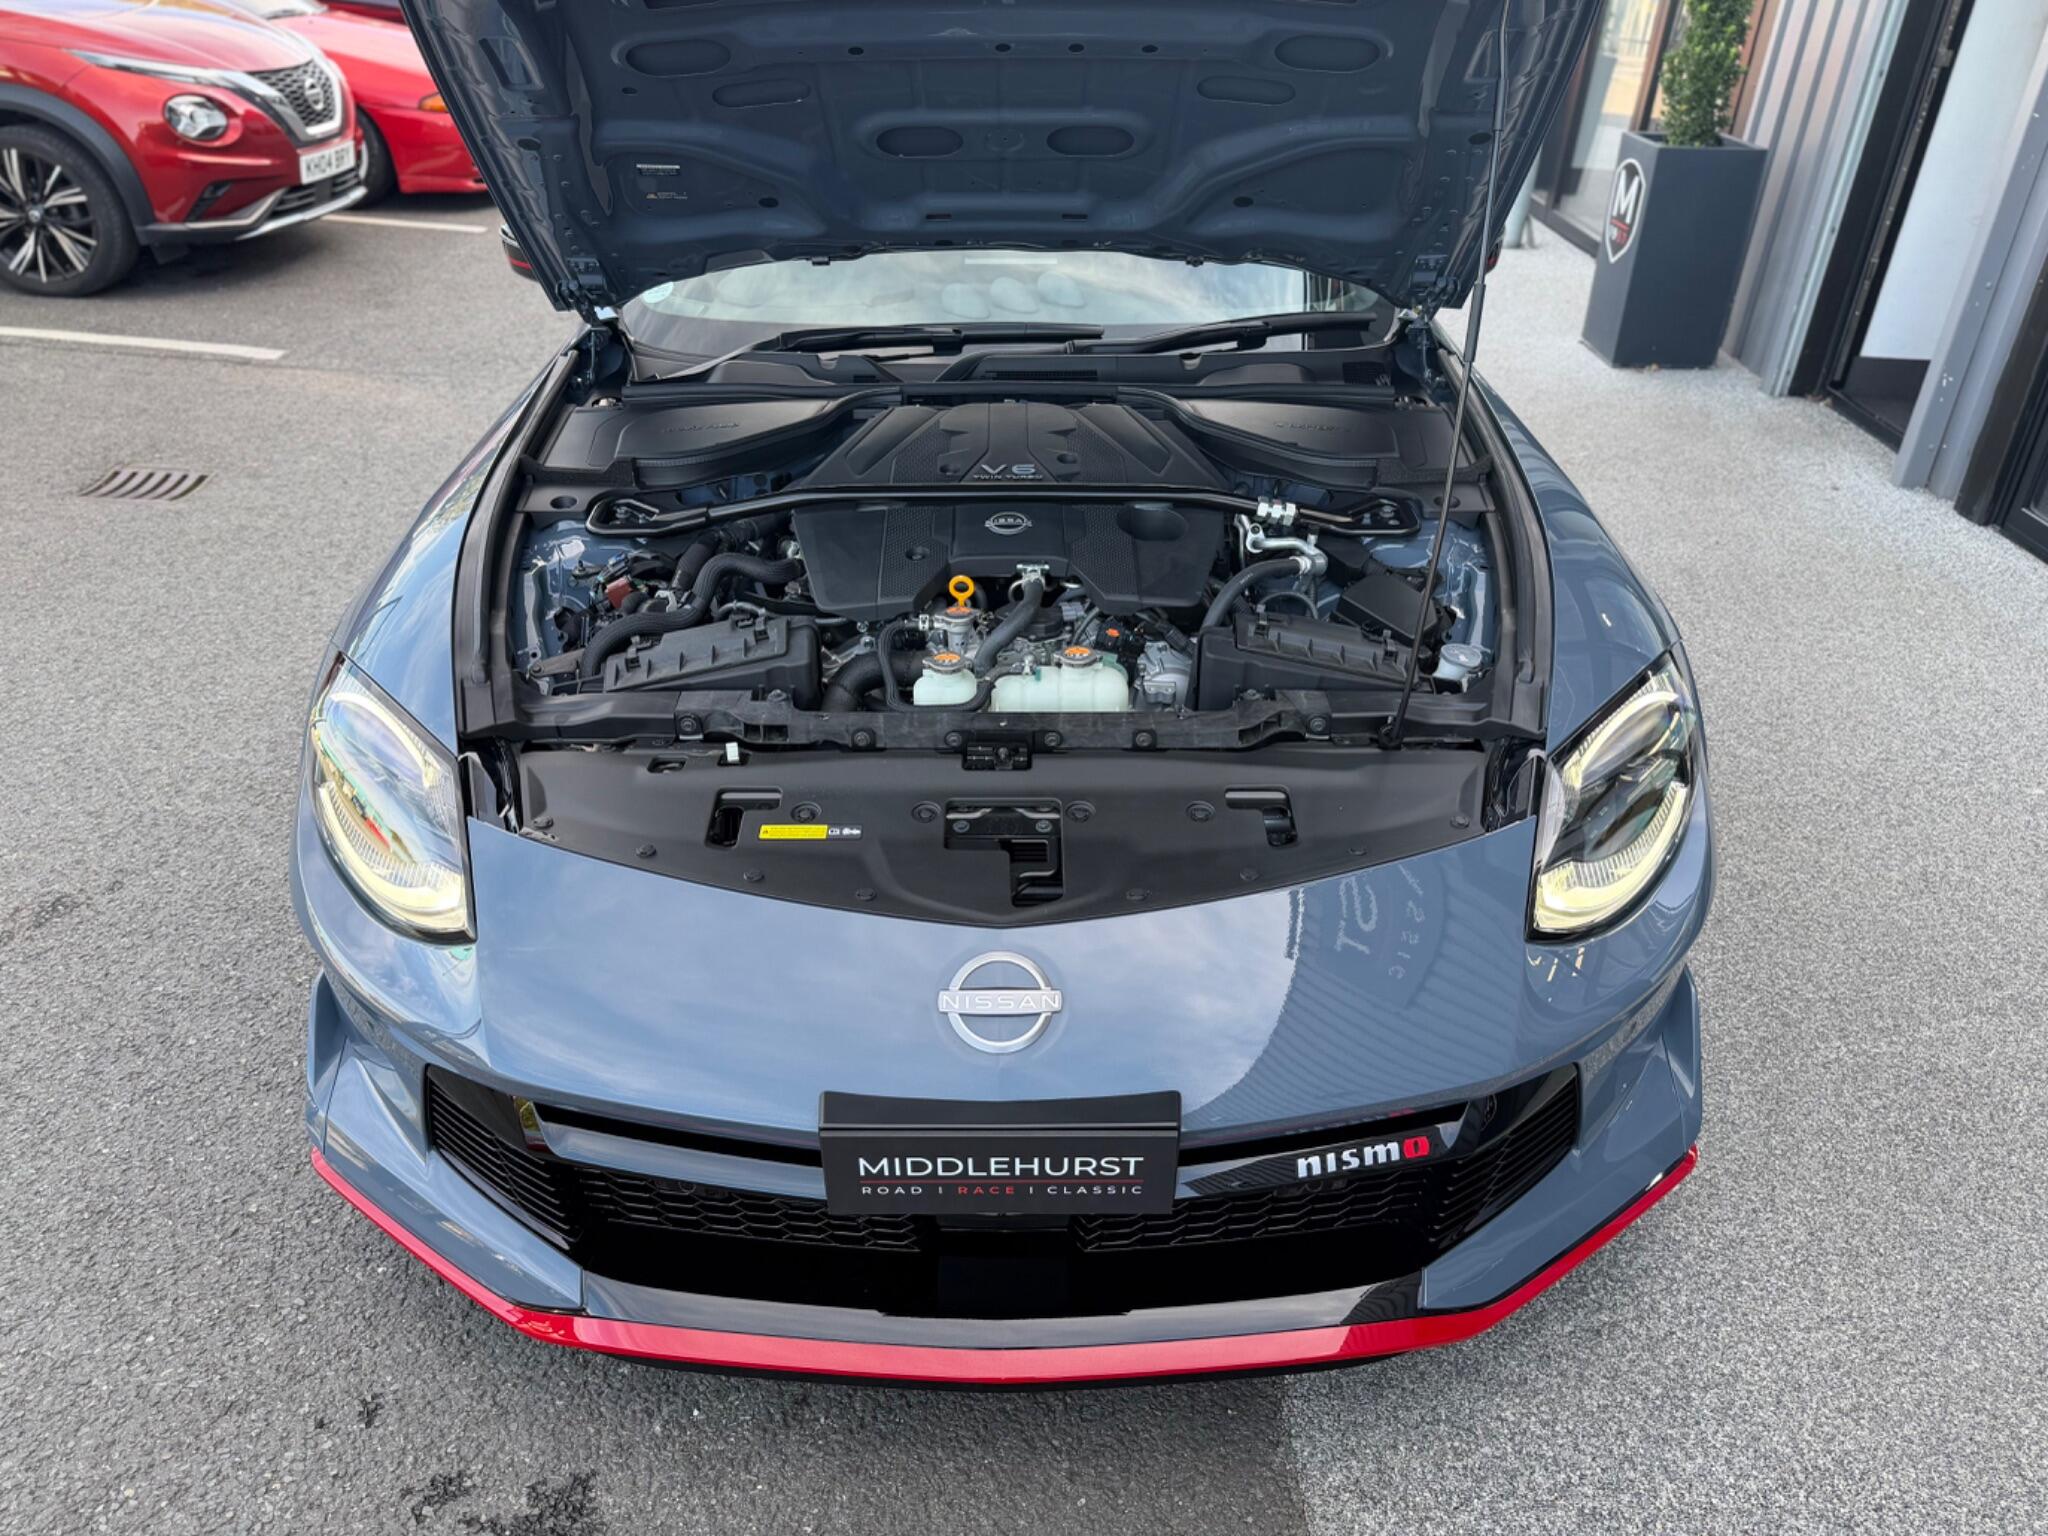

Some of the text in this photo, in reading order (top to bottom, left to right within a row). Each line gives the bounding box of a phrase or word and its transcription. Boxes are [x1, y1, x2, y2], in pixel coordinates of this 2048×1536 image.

[981, 464, 1036, 475] V6
[942, 994, 1060, 1009] NISSAN
[1297, 1135, 1431, 1179] nismo
[858, 1157, 1145, 1176] MIDDLEHURST
[862, 1186, 923, 1195] ROAD
[958, 1186, 1016, 1195] RACE
[1047, 1186, 1143, 1195] CLASSIC
